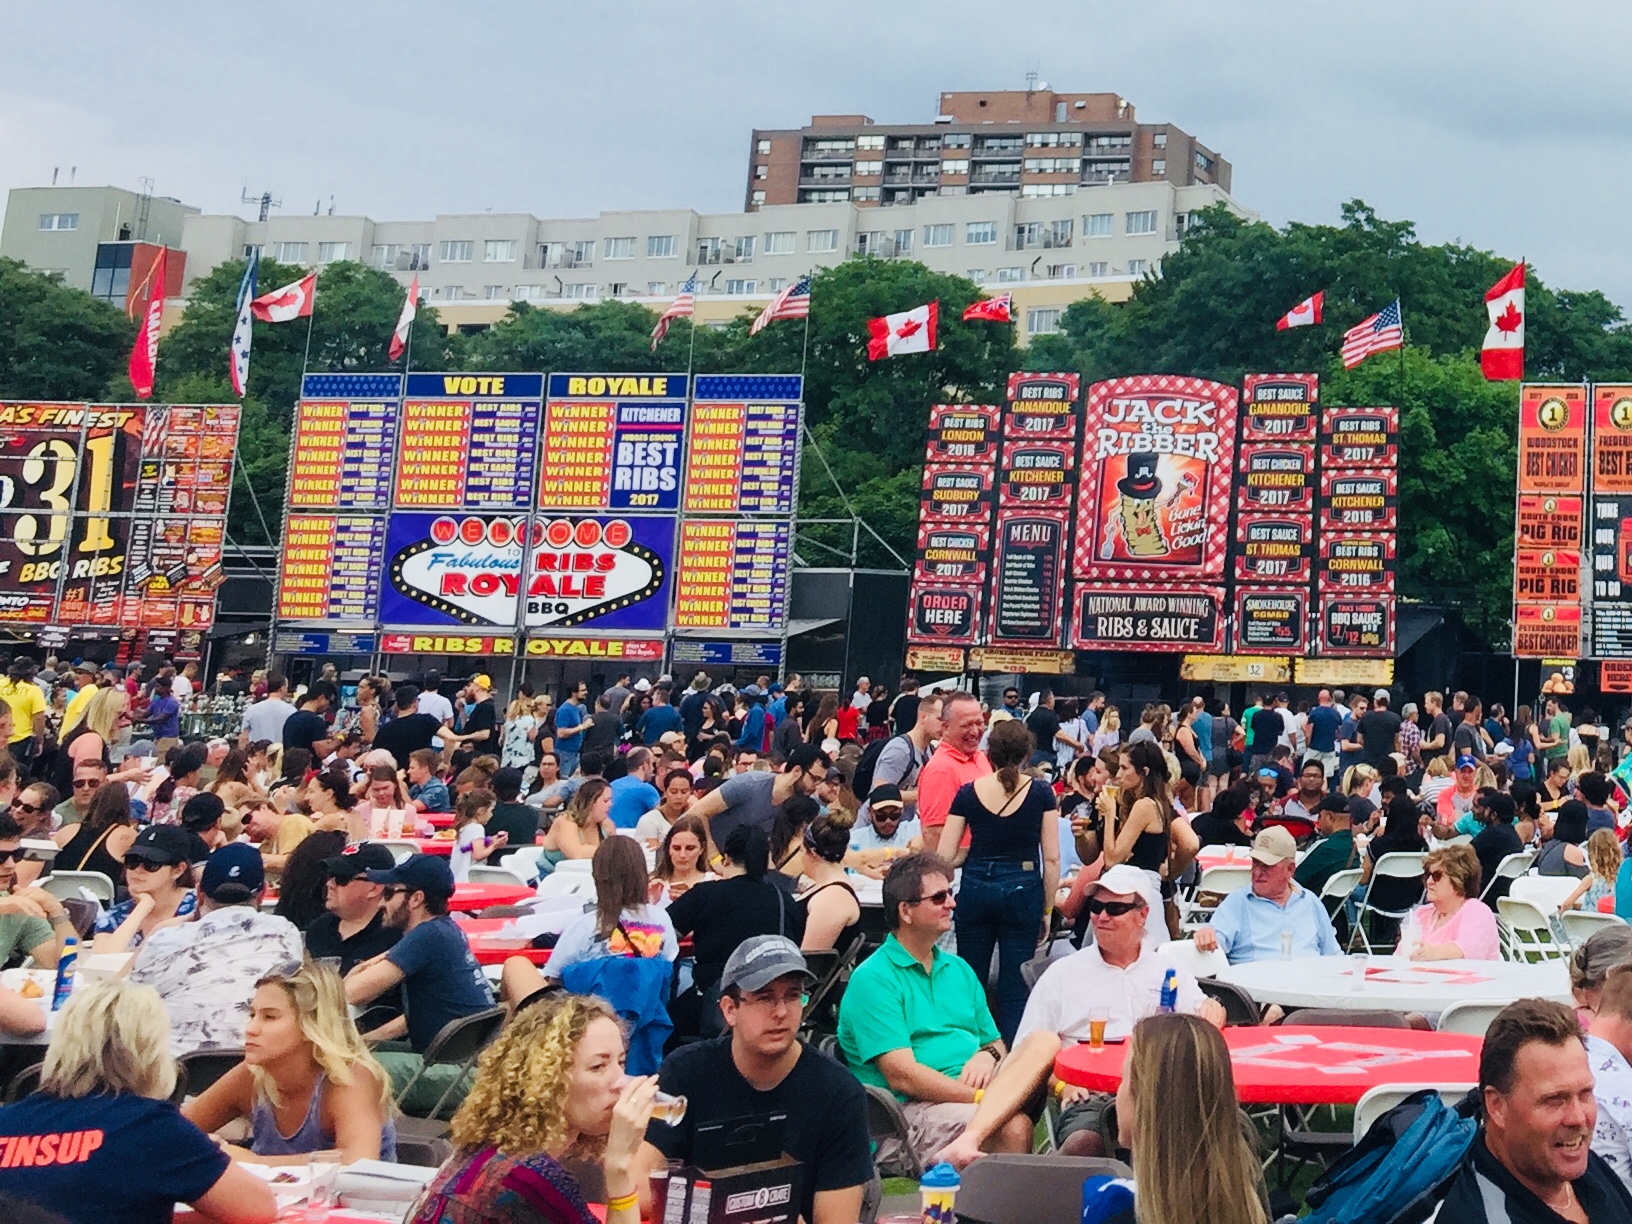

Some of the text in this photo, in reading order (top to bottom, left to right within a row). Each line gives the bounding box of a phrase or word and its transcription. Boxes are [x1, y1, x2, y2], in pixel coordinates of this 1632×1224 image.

[444, 377, 504, 394] VOTE
[568, 378, 667, 395] ROYALE
[1022, 387, 1063, 398] BEST RIBS
[1258, 388, 1303, 400] BEST SAUCE
[38, 409, 133, 427] FINEST
[621, 408, 681, 422] KITCHENER
[1103, 399, 1216, 426] JACK
[1026, 418, 1054, 431] 2017
[1141, 423, 1173, 434] the
[1265, 420, 1294, 434] 2017
[942, 430, 984, 441] LONDON
[1348, 434, 1386, 444] THOMAS
[1096, 428, 1220, 464] RIBBER
[1527, 438, 1578, 448] WOODSTOCK
[617, 442, 678, 466] BEST
[1344, 448, 1374, 460] 2017
[1016, 456, 1060, 468] BEST SAUCE
[615, 467, 676, 491] RIBS
[1010, 471, 1064, 483] KITCHENER
[1248, 474, 1305, 486] KITCHENER
[933, 490, 979, 500] SUDBURY
[1021, 487, 1050, 500] 2017
[1336, 483, 1381, 494] BEST SAUCE
[14, 436, 114, 556] 31
[630, 494, 659, 505] 2017
[1260, 491, 1290, 504] 2017
[1332, 497, 1385, 507] KITCHENER
[942, 504, 968, 516] 2017
[1169, 505, 1201, 521] Bone
[1596, 502, 1618, 518] TAKE
[1344, 511, 1372, 523] 2016
[432, 520, 630, 545] WELCOME
[1010, 525, 1051, 542] MENU
[1251, 528, 1298, 540] BEST SAUCE
[1521, 525, 1577, 540] PIG RIG
[925, 550, 977, 560] CORNWALL
[1260, 544, 1300, 556] THOMAS
[1336, 546, 1378, 556] BEST RIBS
[19, 556, 124, 582] BBQ RIBS
[427, 553, 617, 573] Fabulous RIBS
[1257, 560, 1287, 575] 2017
[1329, 559, 1384, 570] CORNWALL
[937, 564, 963, 576] 2017
[440, 573, 606, 599] ROYALE
[1342, 574, 1370, 586] 2016
[1519, 579, 1576, 593] PIG RIG
[1595, 581, 1620, 597] TO GO
[527, 602, 569, 615] BBQ
[923, 595, 967, 609] ORDER
[1089, 597, 1209, 617] NATIONAL AWARD WINNING
[925, 610, 963, 624] HERE
[1331, 613, 1382, 624] BBQ SAUCE
[1097, 617, 1199, 639] RIBS & SAUCE
